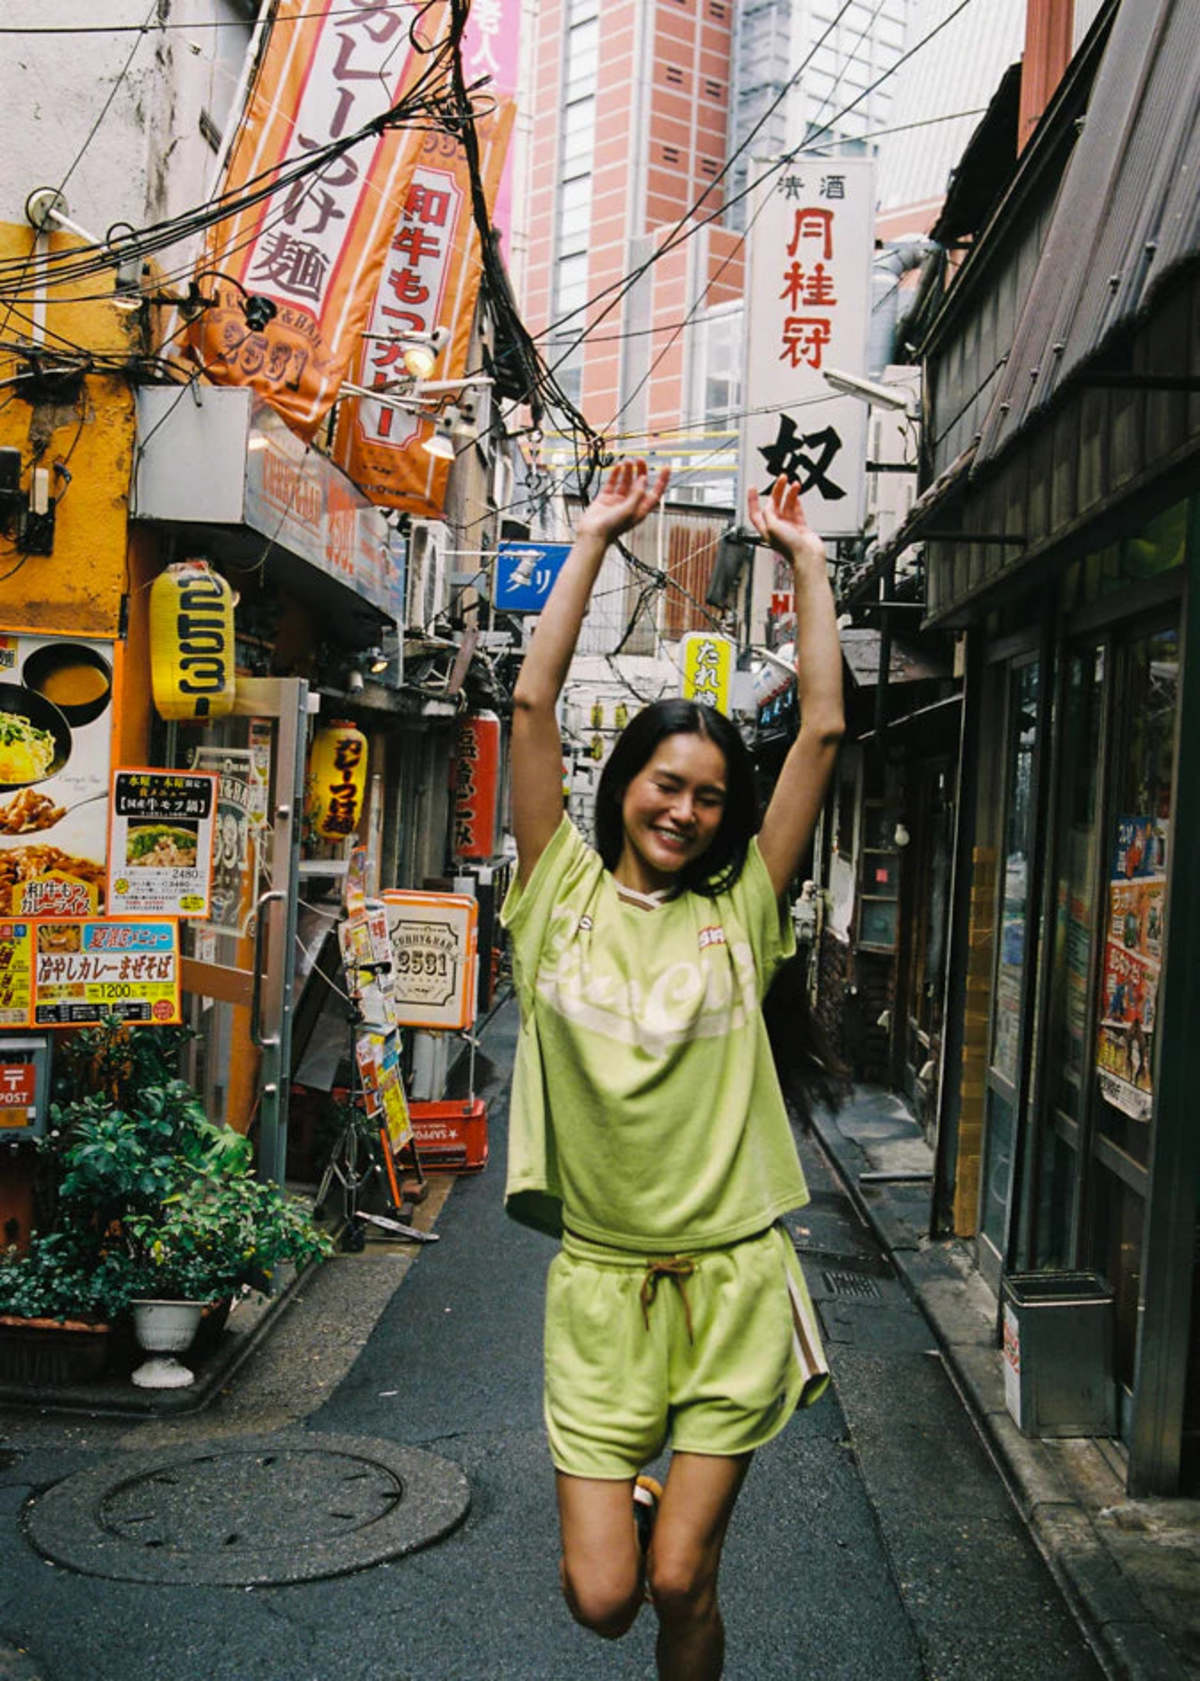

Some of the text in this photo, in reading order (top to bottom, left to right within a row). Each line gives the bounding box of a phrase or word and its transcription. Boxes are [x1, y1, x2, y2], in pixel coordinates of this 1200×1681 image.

[779, 207, 838, 370] 月桂冠
[757, 412, 848, 500] 奴
[28, 882, 86, 898] 和牛もつ
[38, 954, 173, 983] 冷やしカレーまぜそば
